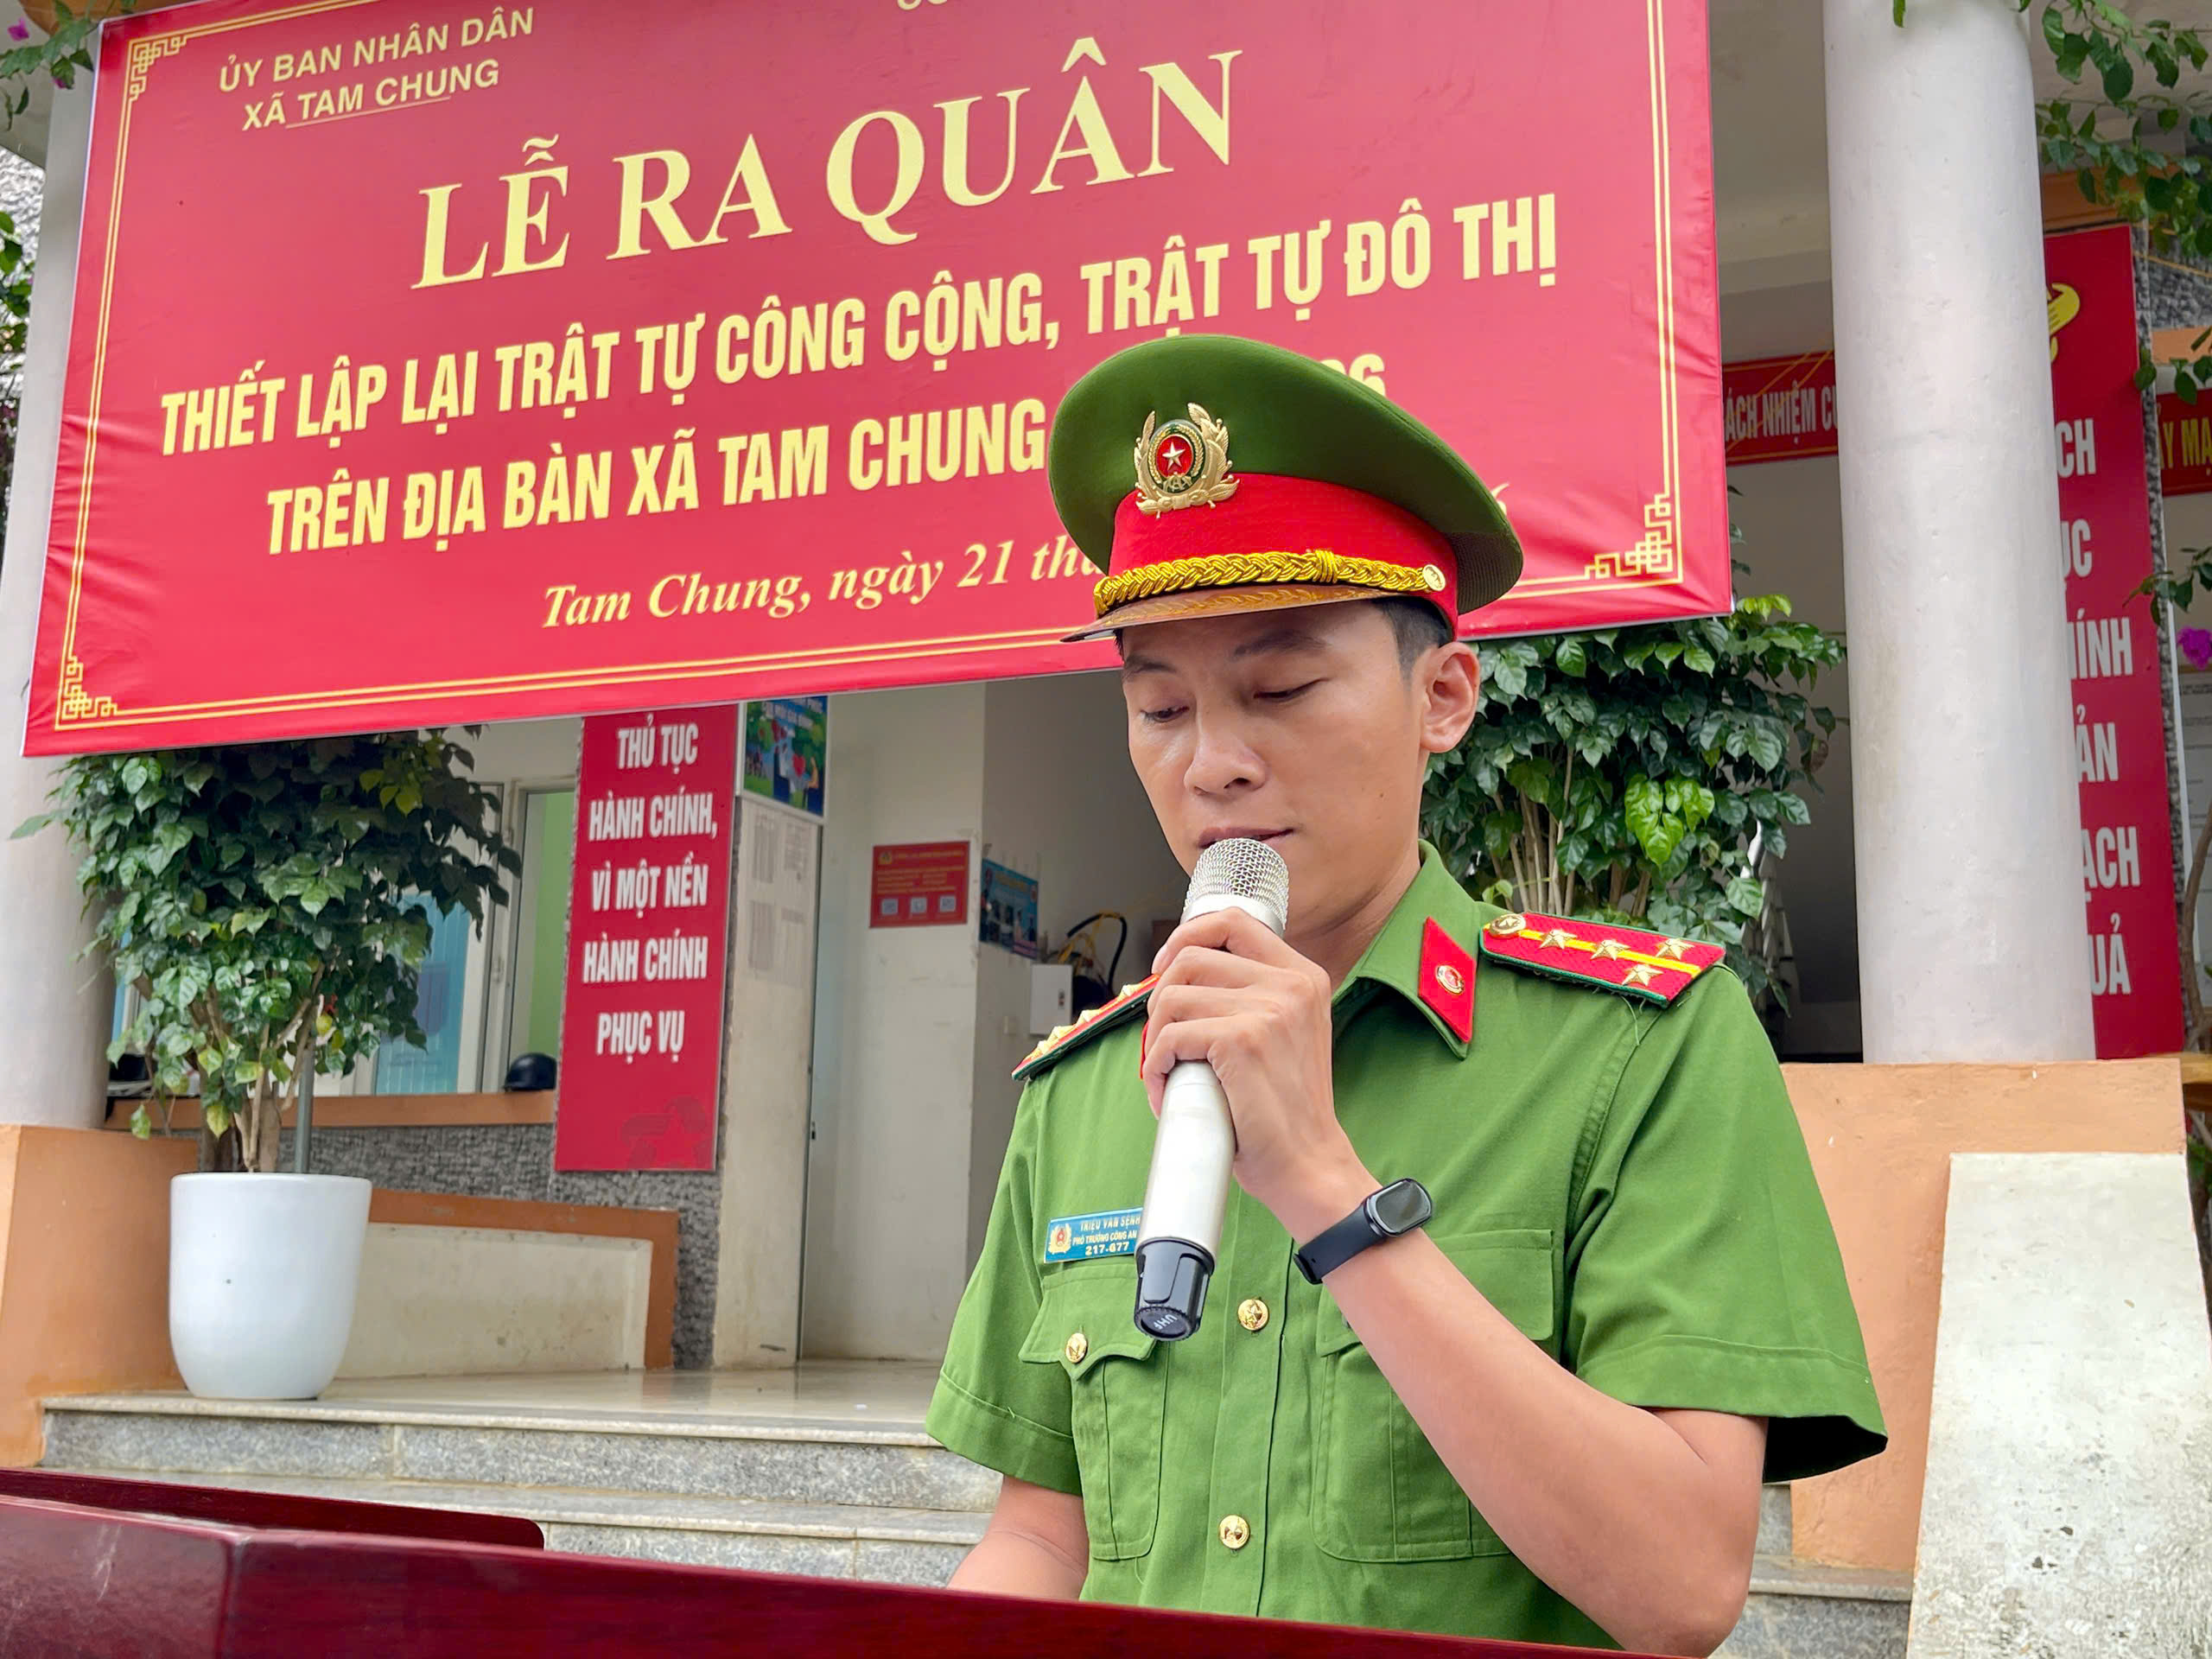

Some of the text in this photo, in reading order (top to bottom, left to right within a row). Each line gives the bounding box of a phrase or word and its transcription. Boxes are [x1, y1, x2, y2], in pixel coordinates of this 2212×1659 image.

[219, 6, 534, 92] ỦY BAN NHÂN DÂN
[241, 59, 499, 131] XÃ TAM CHUNG
[410, 36, 1243, 290] LỄ RA QUÂN
[161, 193, 1556, 456] THIẾT LẬP LẠI TRẬT TỰ CÔNG CỘNG, TRẬT TỰ ĐÔ THỊ
[1761, 379, 1817, 445] NHIỆM
[267, 397, 1046, 555] TRÊN ĐỊA BÀN XÃ TAM CHUNG
[542, 585, 631, 629] Tam
[648, 573, 811, 619] Chung,
[828, 550, 945, 611] ngày
[956, 539, 1015, 589] 21
[615, 713, 699, 775] THỦ TỤC
[588, 785, 718, 842] HÀNH CHÍNH,
[591, 861, 612, 912] VÌ
[614, 857, 662, 919] MỘT
[663, 851, 709, 908] NỀN
[582, 931, 639, 984] HÀNH
[644, 927, 709, 982] CHÍNH
[596, 1009, 686, 1065] PHỤC VỤ
[1109, 1230, 1128, 1242] CÔNG
[1128, 1230, 1138, 1240] AN
[1153, 1313, 1179, 1331] UHF
